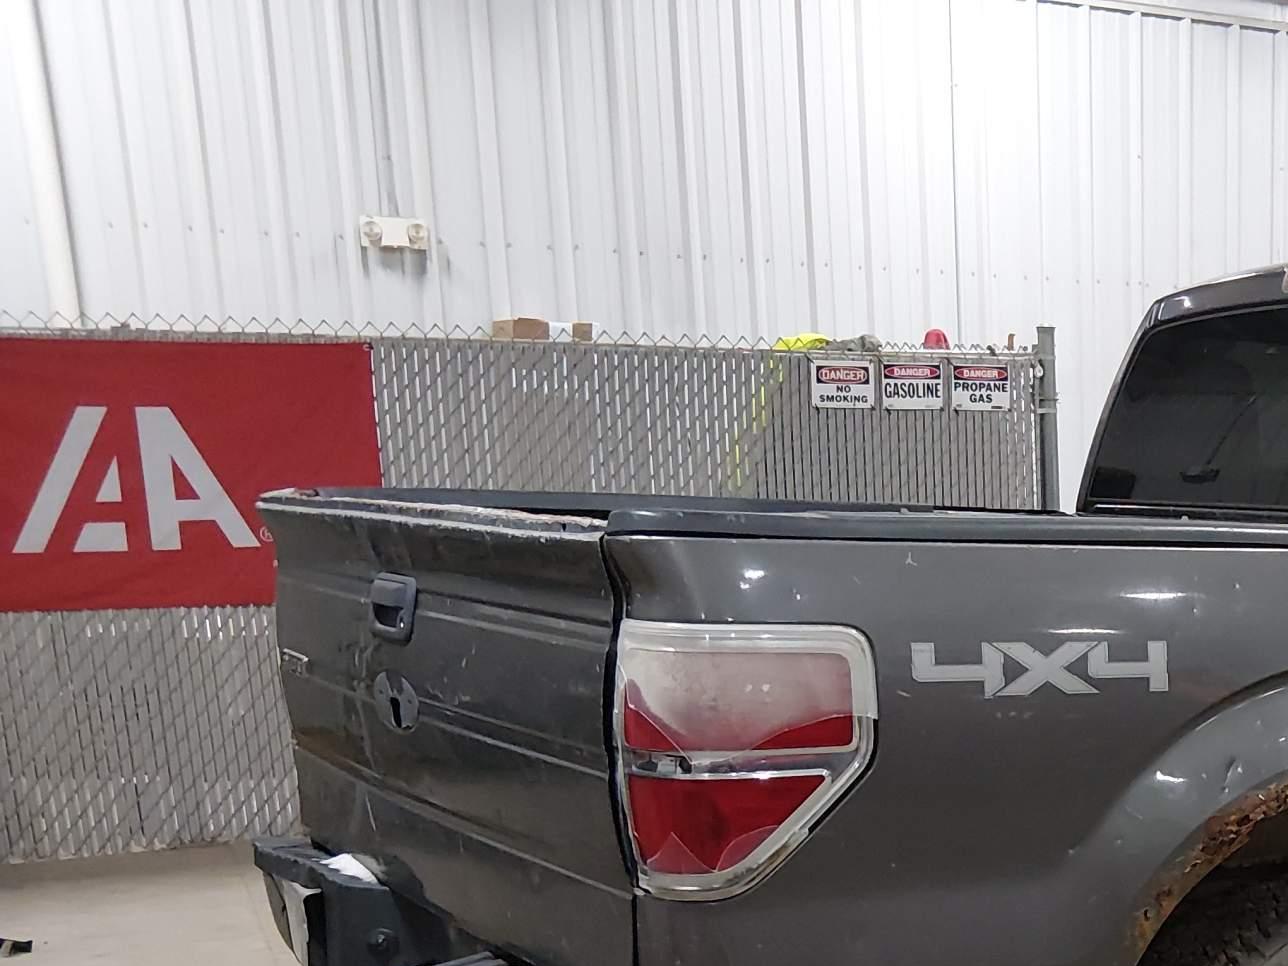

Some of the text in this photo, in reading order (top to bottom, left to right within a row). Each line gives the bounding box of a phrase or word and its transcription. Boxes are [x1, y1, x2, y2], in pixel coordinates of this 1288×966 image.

[822, 368, 864, 380] DANGER
[893, 367, 930, 377] DANGER
[963, 369, 999, 379] DANGER
[836, 385, 852, 393] NO
[884, 382, 941, 398] GASOLINE
[953, 382, 1009, 392] PROPANE
[819, 394, 868, 403] SMOKING
[969, 393, 993, 403] GAS
